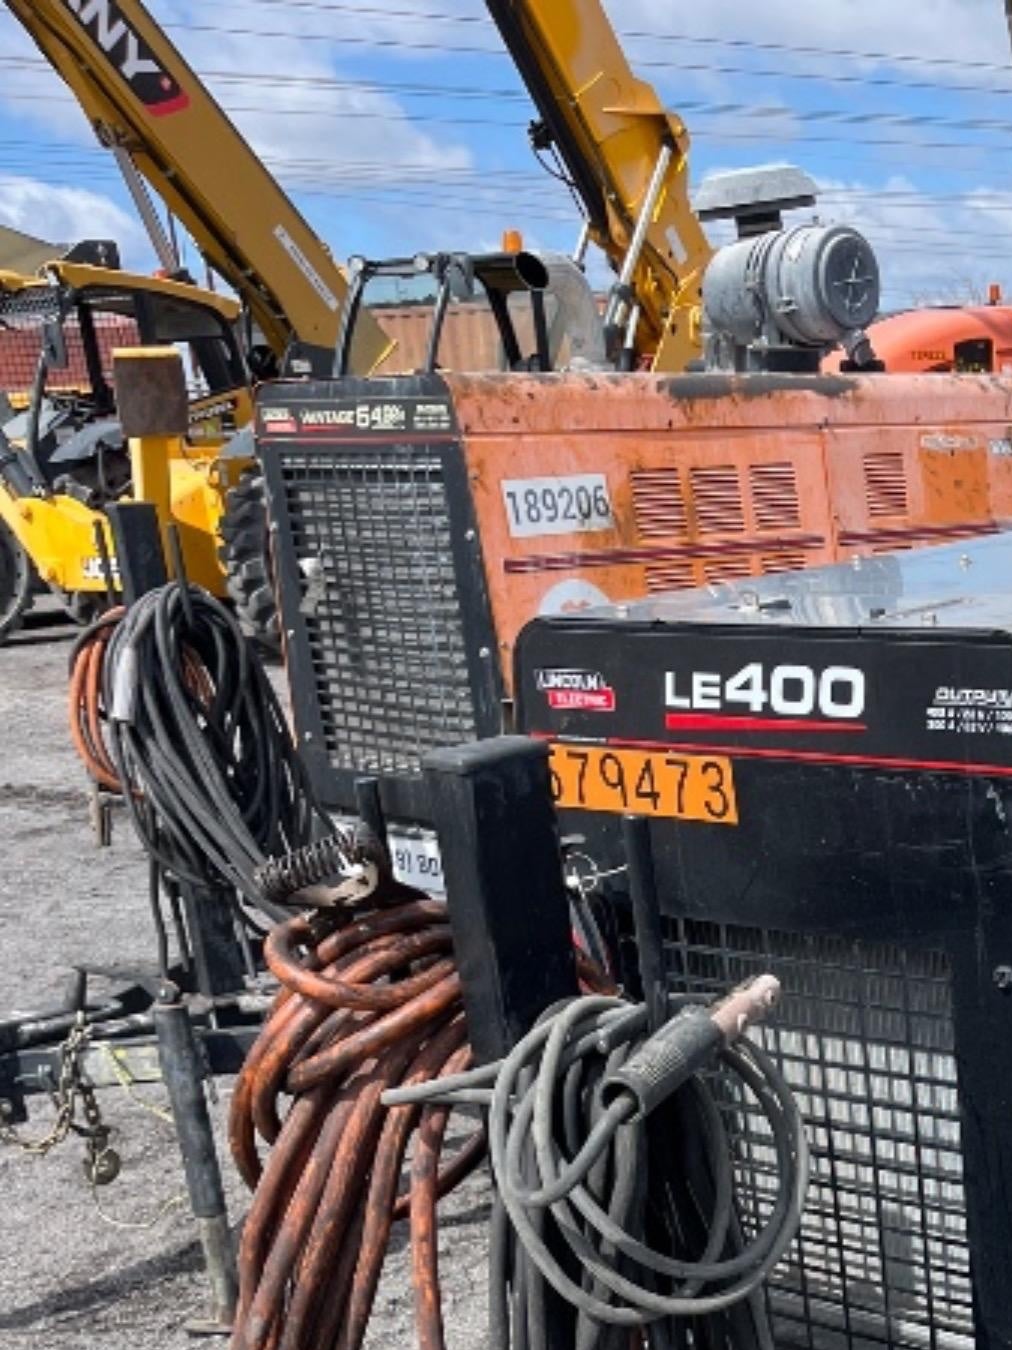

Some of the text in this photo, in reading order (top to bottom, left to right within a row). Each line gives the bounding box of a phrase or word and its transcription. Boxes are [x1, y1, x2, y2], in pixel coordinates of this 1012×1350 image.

[67, 0, 163, 79] NY
[506, 485, 609, 525] 189206
[664, 662, 866, 718] LE400
